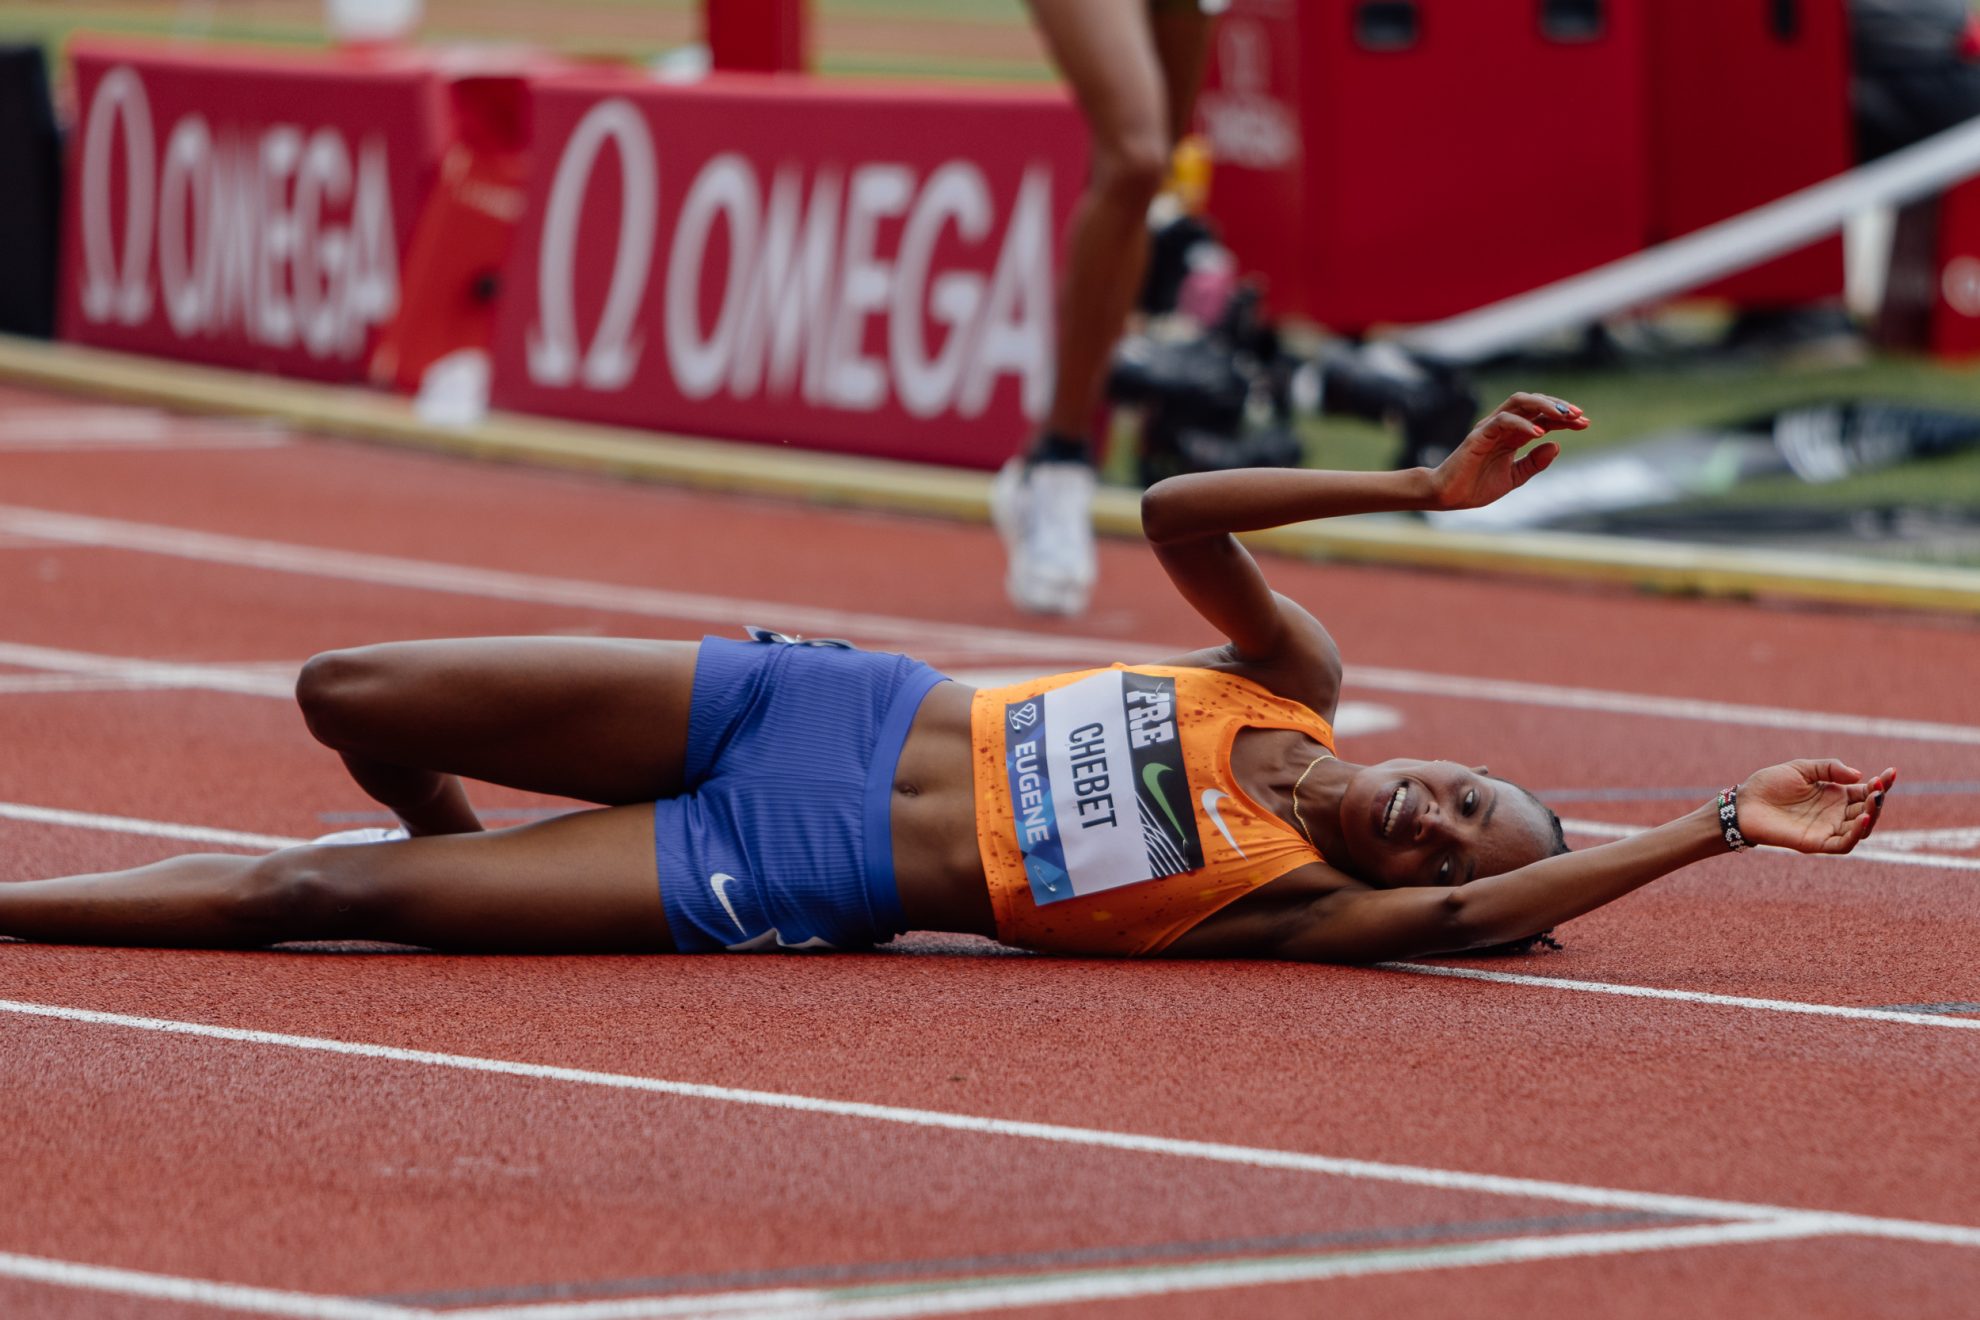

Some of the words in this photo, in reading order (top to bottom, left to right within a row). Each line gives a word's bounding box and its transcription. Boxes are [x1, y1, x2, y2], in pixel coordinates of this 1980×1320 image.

[159, 113, 398, 358] OMEGA
[664, 152, 1055, 421] OMEGA
[1127, 691, 1174, 749] PRE
[1015, 740, 1050, 844] EUGENE
[1068, 722, 1117, 829] CHEBET
